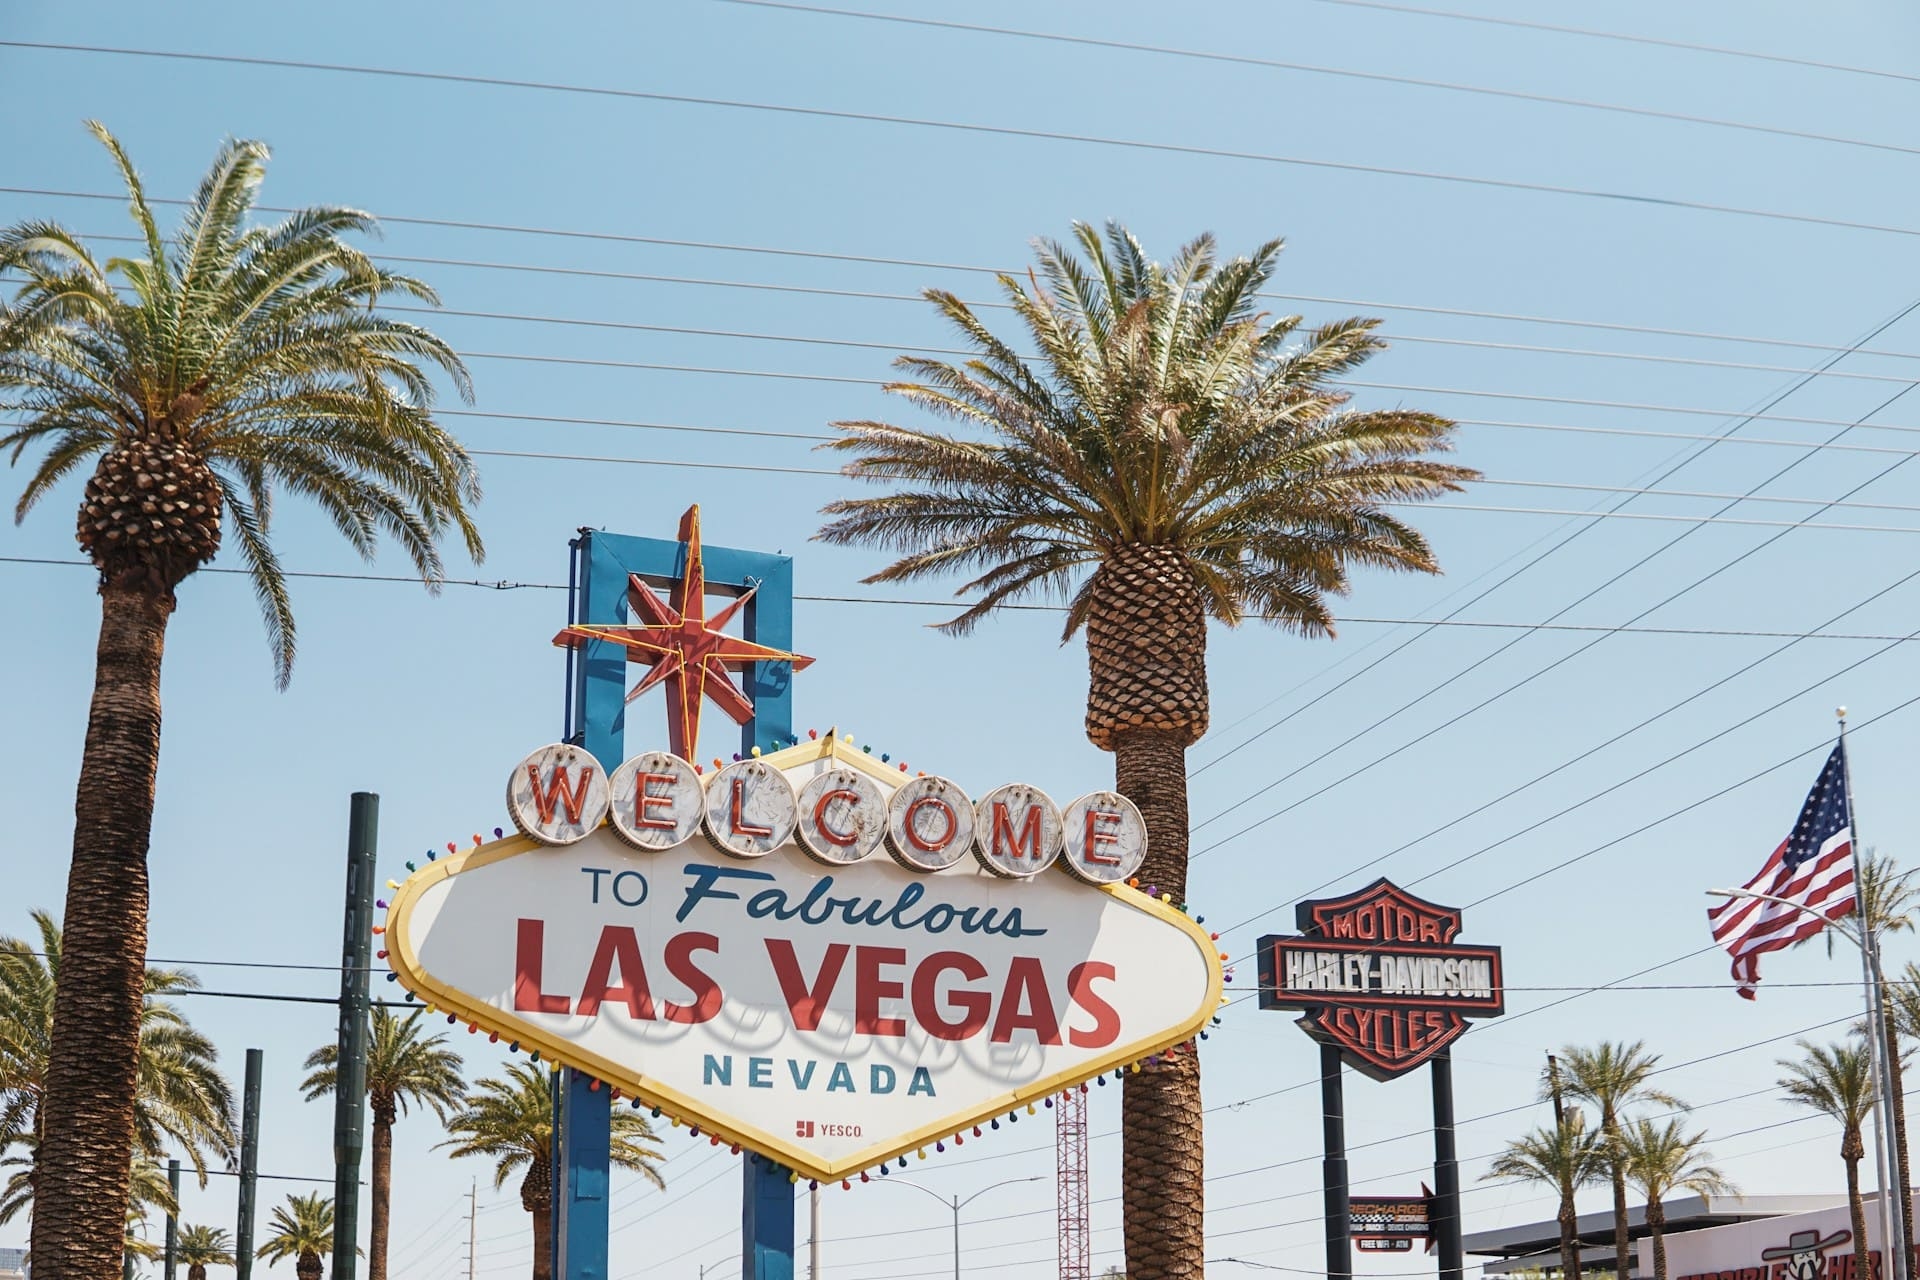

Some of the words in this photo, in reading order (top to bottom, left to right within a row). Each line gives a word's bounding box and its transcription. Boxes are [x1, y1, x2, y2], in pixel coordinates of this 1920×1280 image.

[527, 763, 1122, 866] WELCOME
[581, 867, 648, 907] TO
[675, 863, 1048, 938] Fabulous
[1333, 900, 1441, 944] MOTOR
[513, 918, 721, 1024] LAS
[764, 937, 1122, 1049] VEGAS
[1285, 951, 1491, 998] HARLEY-DAVIDSON
[1336, 1007, 1444, 1060] CYCLES
[703, 1054, 937, 1098] NEVADA
[821, 1124, 861, 1138] YESCO
